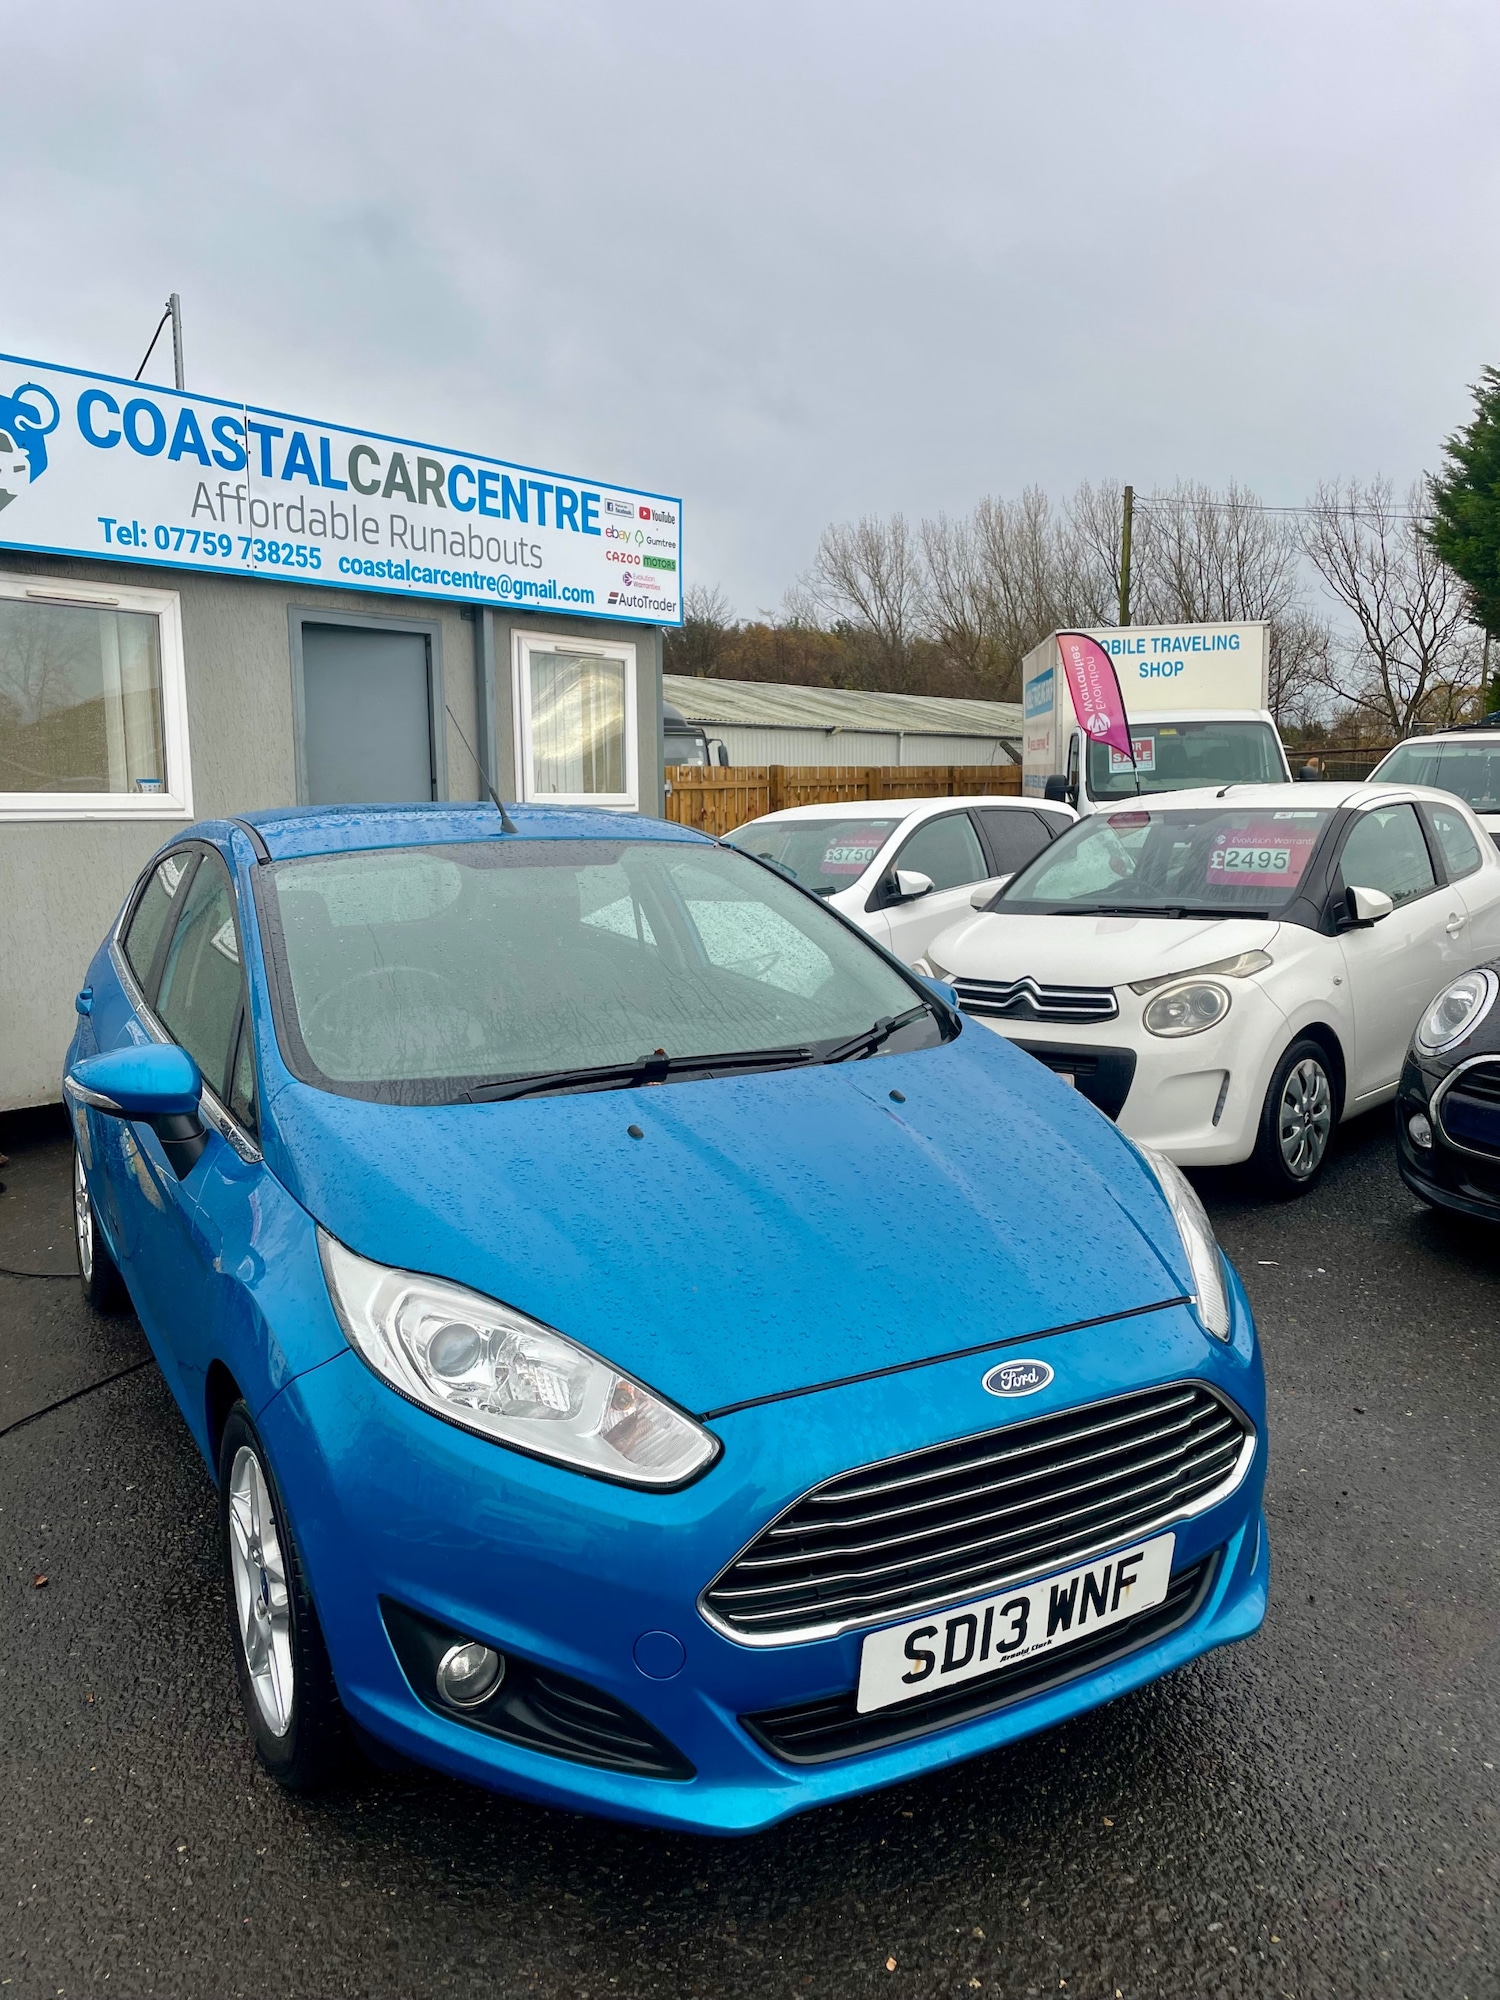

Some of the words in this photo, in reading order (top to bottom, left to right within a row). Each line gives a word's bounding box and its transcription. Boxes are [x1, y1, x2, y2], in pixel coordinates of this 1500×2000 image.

[191, 481, 380, 545] Affordable
[390, 513, 543, 569] Runabouts
[651, 509, 676, 525] YouTube
[97, 516, 148, 547] Tel:
[154, 525, 232, 557] 07759
[237, 536, 322, 569] 738255
[606, 524, 631, 543] ebay
[646, 536, 677, 549] Gumtree
[605, 550, 641, 565] CAZOO
[338, 555, 595, 604] coastalcarcentre@gmail.com
[633, 573, 655, 583] Evolution
[633, 581, 661, 591] Warranties
[619, 593, 677, 612] AutoTrader
[1100, 638, 1146, 655] OBILE
[1151, 634, 1240, 653] TRAVELING
[1139, 661, 1184, 678] SHOP
[1231, 836, 1271, 845] Evolution
[1274, 837, 1316, 845] Warranti
[1211, 849, 1288, 870] £2495
[1000, 1366, 1039, 1390] Ford
[901, 1596, 1030, 1685] SD13
[1046, 1552, 1144, 1638] WNF
[1030, 1639, 1053, 1652] Clark
